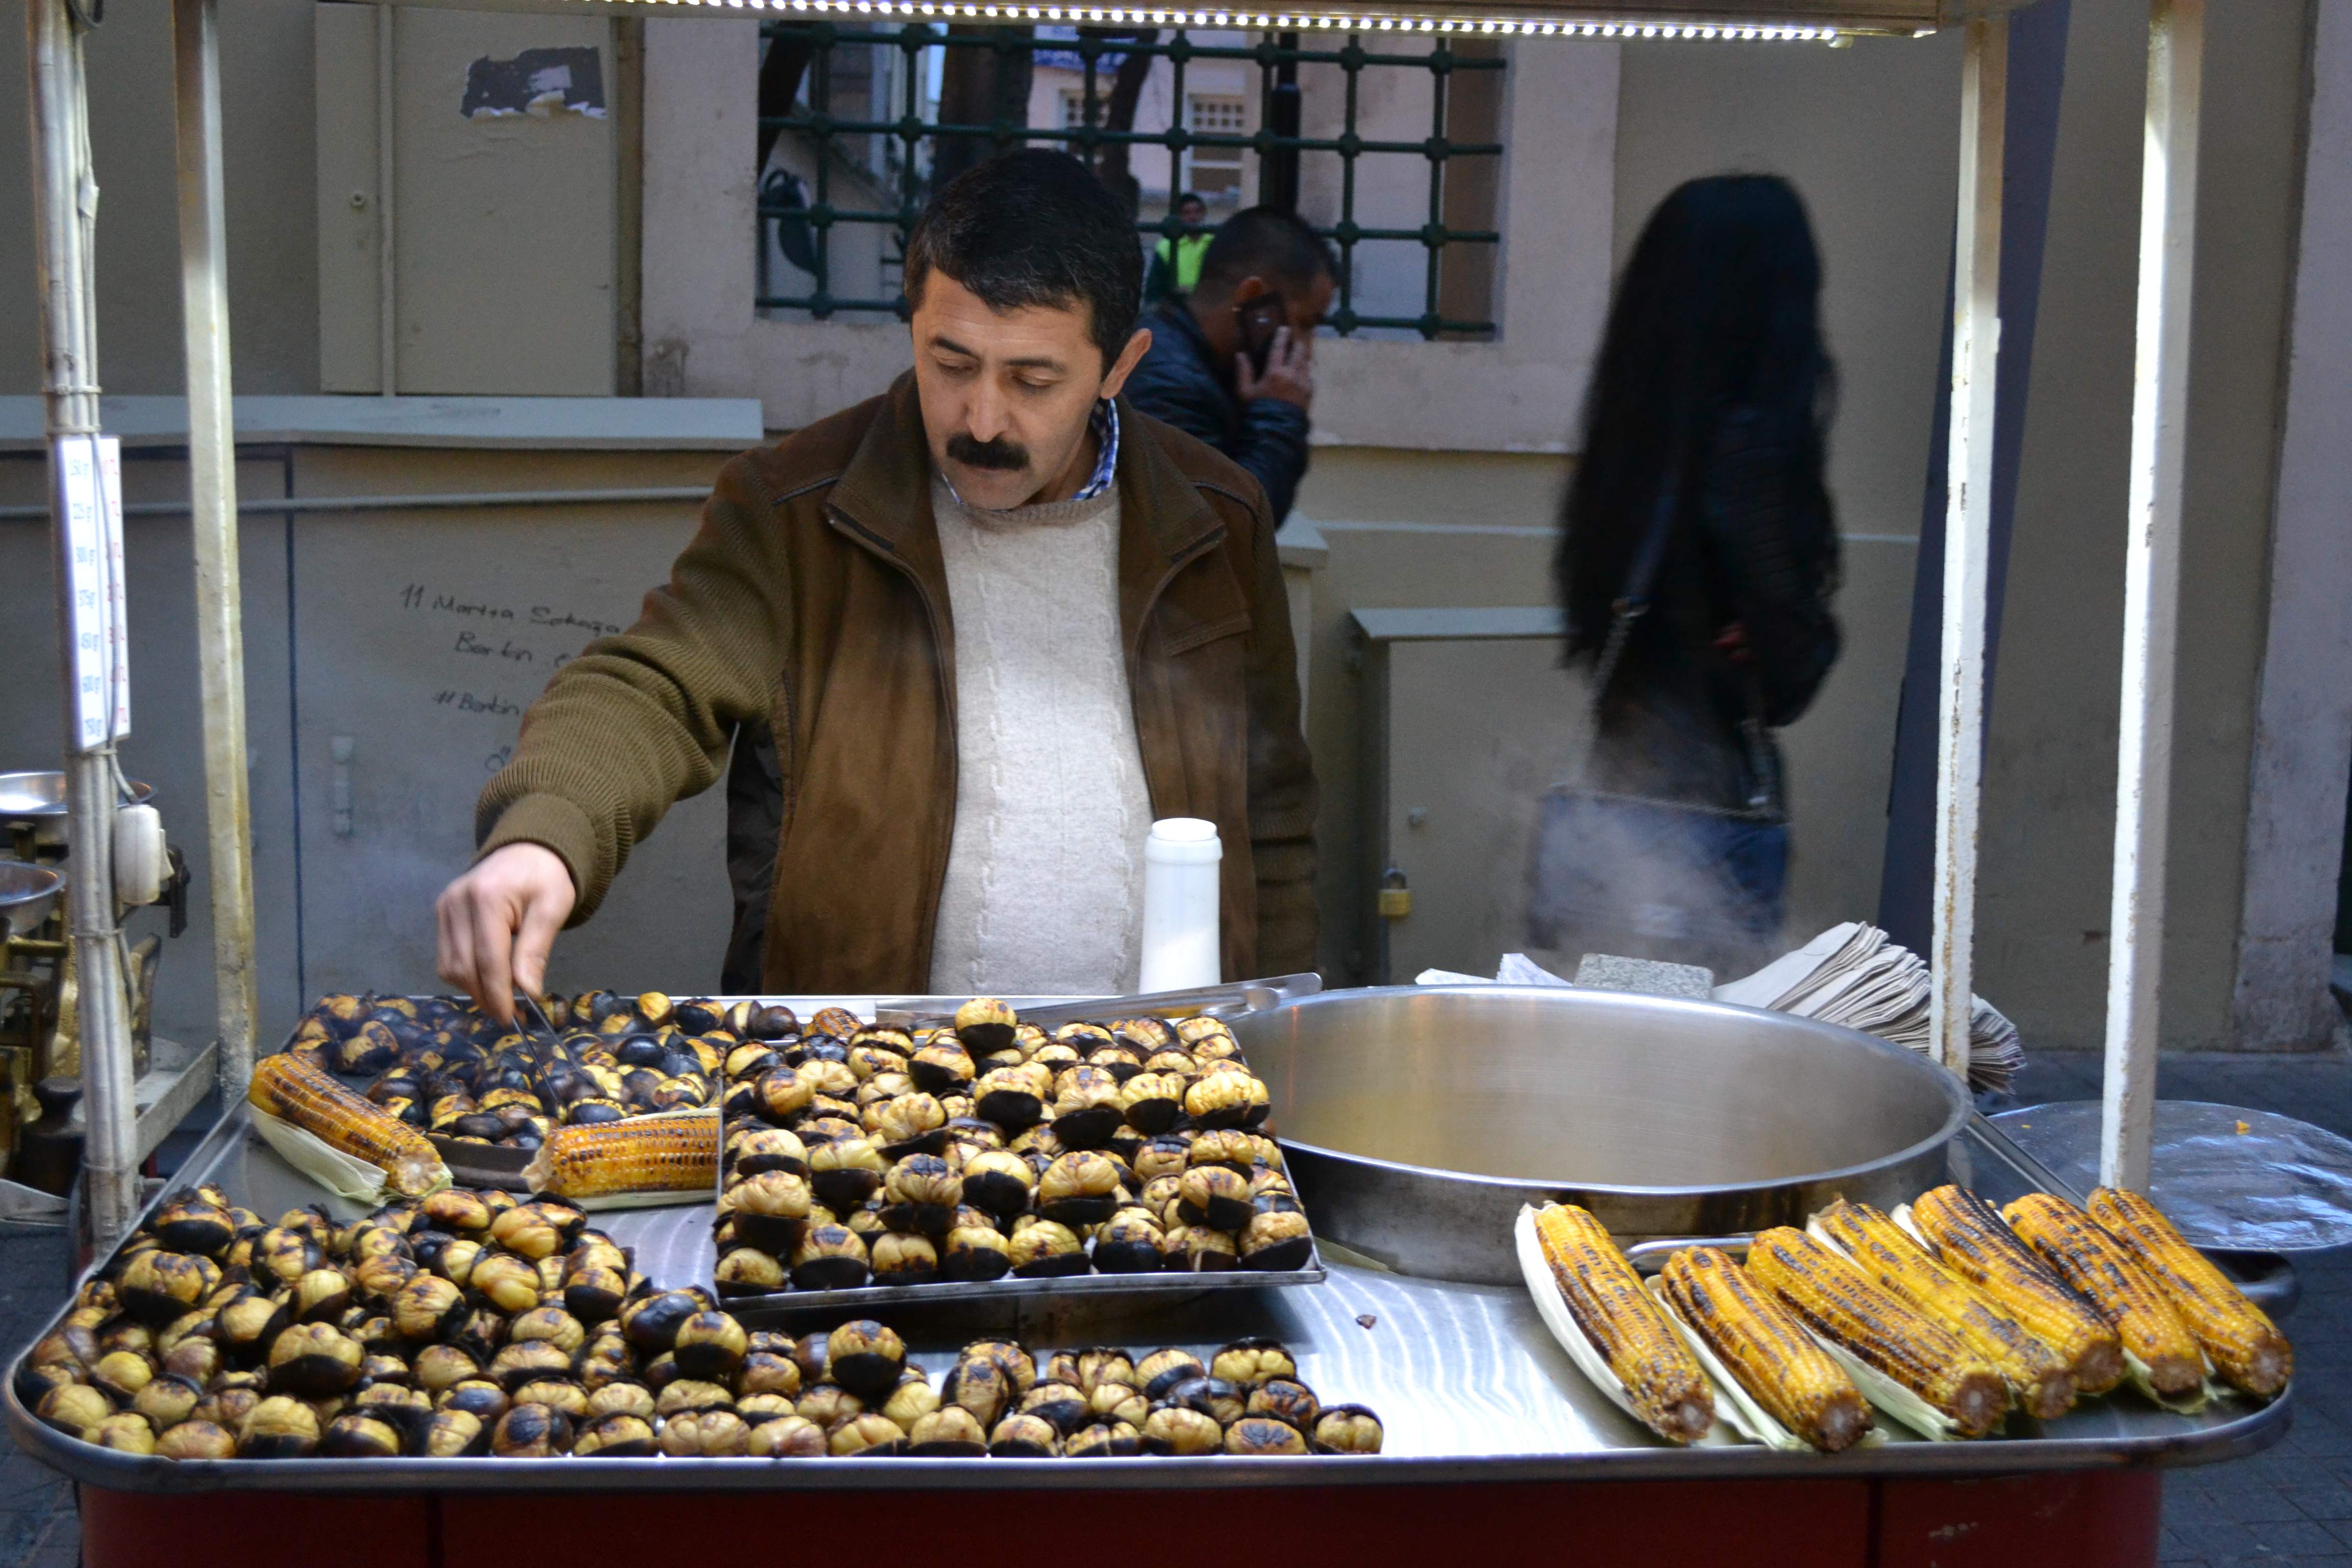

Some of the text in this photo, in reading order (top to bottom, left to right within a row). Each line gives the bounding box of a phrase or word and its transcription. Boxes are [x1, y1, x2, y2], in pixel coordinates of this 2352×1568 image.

[83, 463, 89, 479] gr
[72, 502, 92, 523] 225 gr
[76, 546, 87, 563] 300
[89, 549, 95, 566] gr
[399, 583, 424, 608] 11
